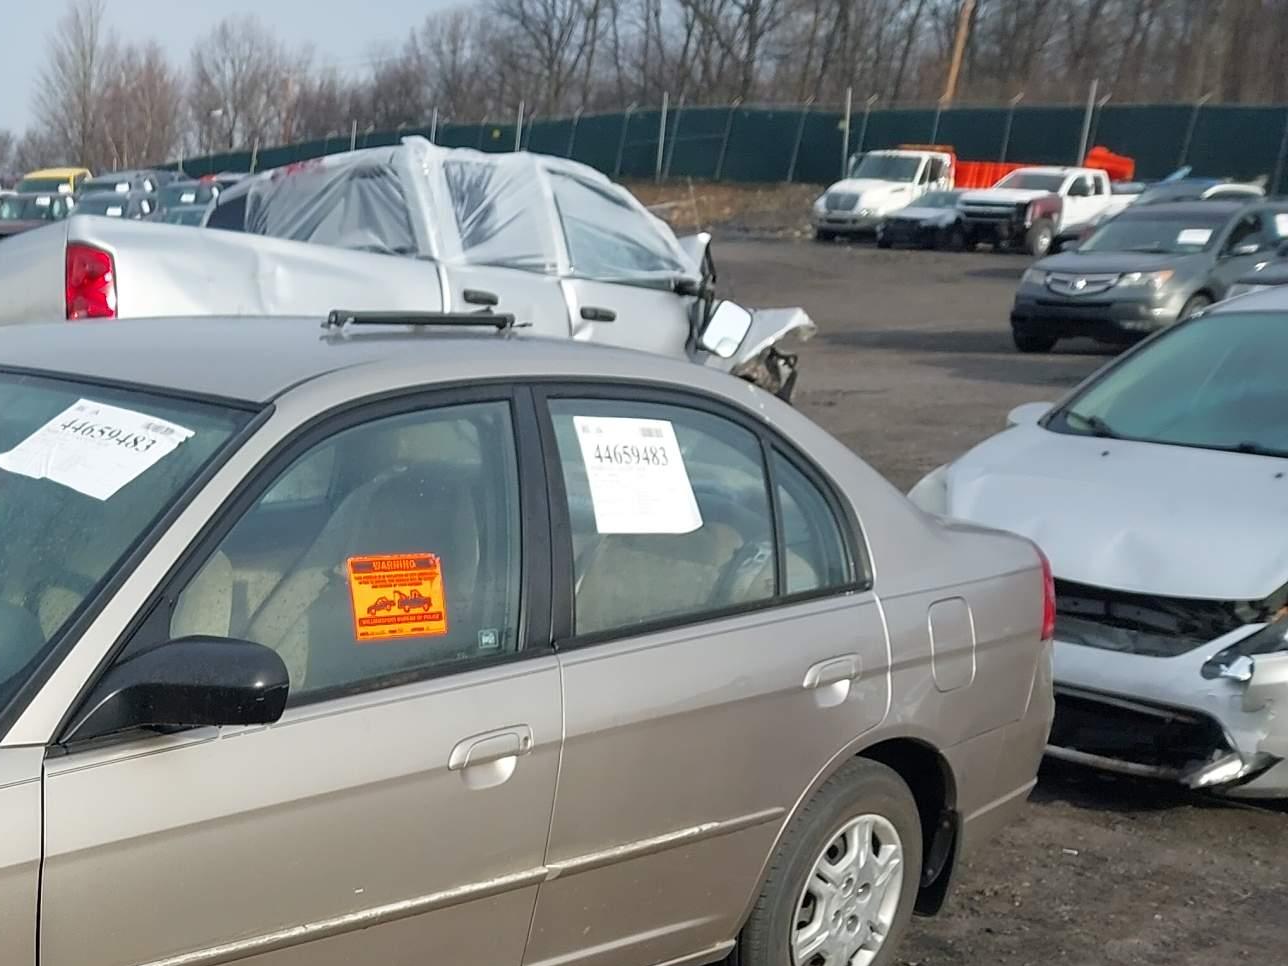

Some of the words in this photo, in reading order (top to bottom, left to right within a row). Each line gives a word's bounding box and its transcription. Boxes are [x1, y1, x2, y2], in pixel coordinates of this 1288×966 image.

[60, 418, 158, 453] 44659483
[594, 443, 669, 467] 44659483
[372, 559, 417, 571] WARNING
